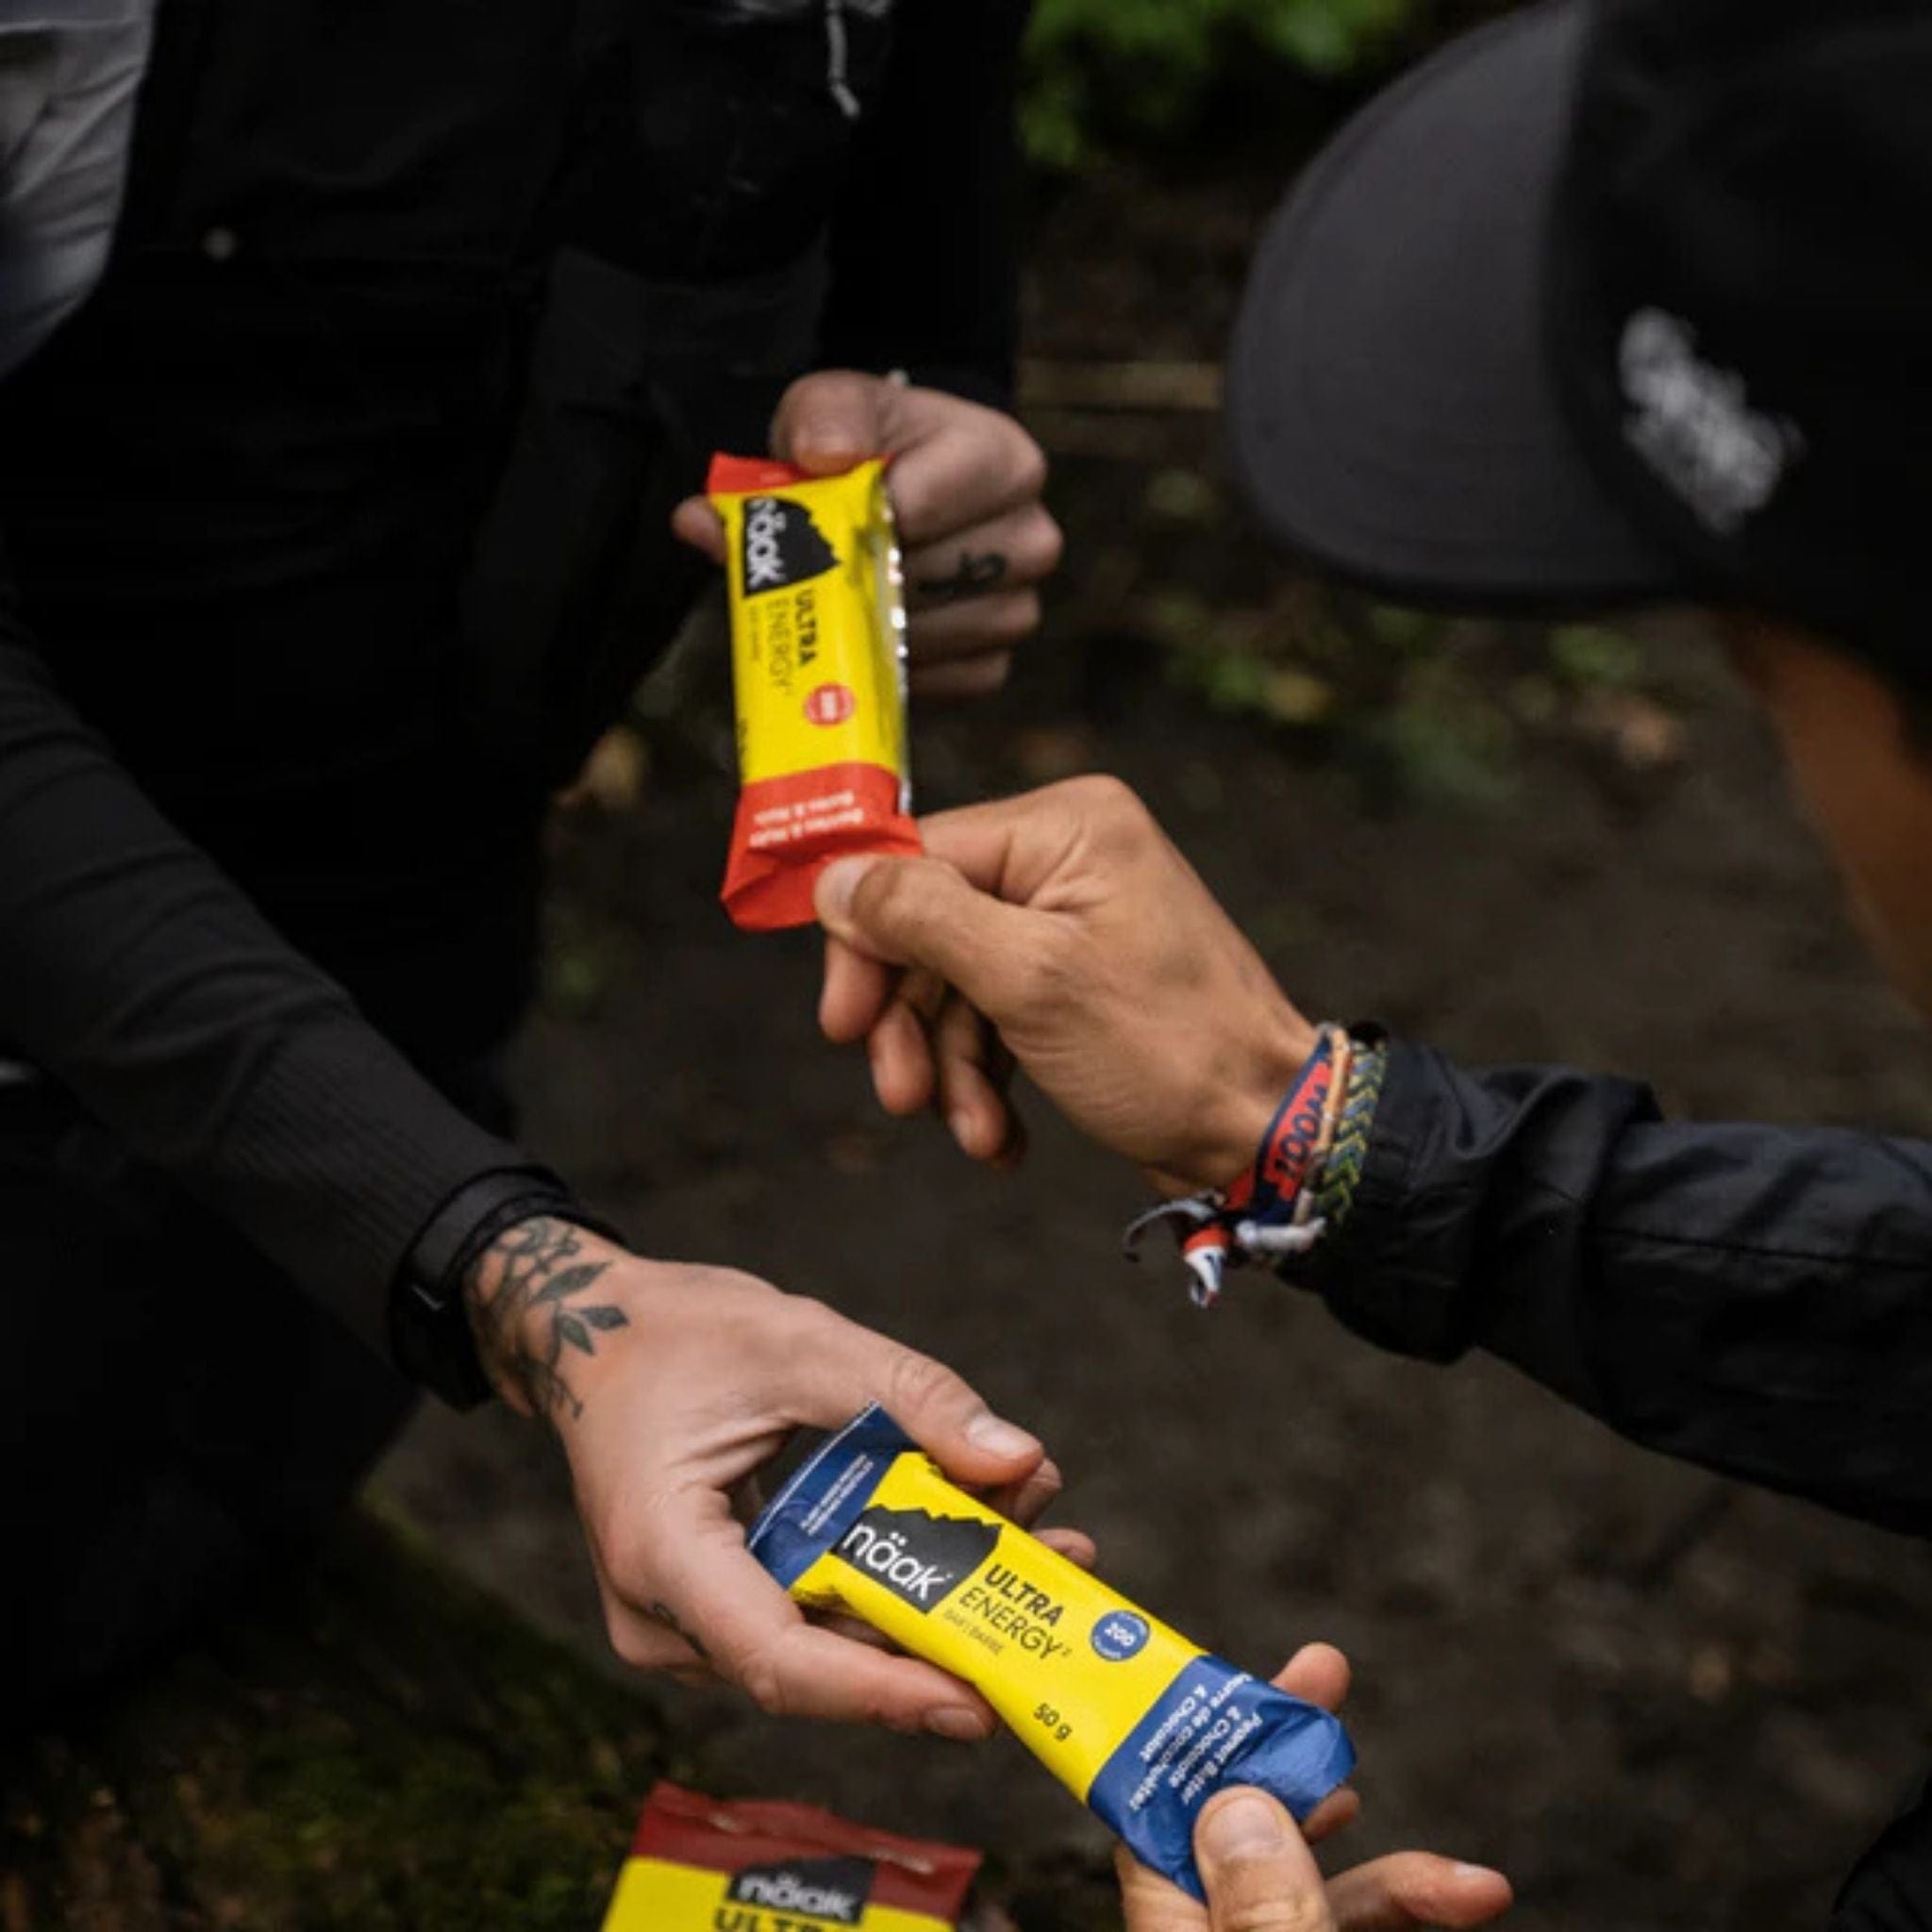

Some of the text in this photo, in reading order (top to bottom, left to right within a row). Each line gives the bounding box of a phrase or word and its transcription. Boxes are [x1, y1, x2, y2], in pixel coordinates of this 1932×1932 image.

[795, 589, 818, 667] ULTRA
[842, 1523, 945, 1602] näak
[985, 1563, 1065, 1626] ULTRA
[1033, 1703, 1073, 1741] 50 g
